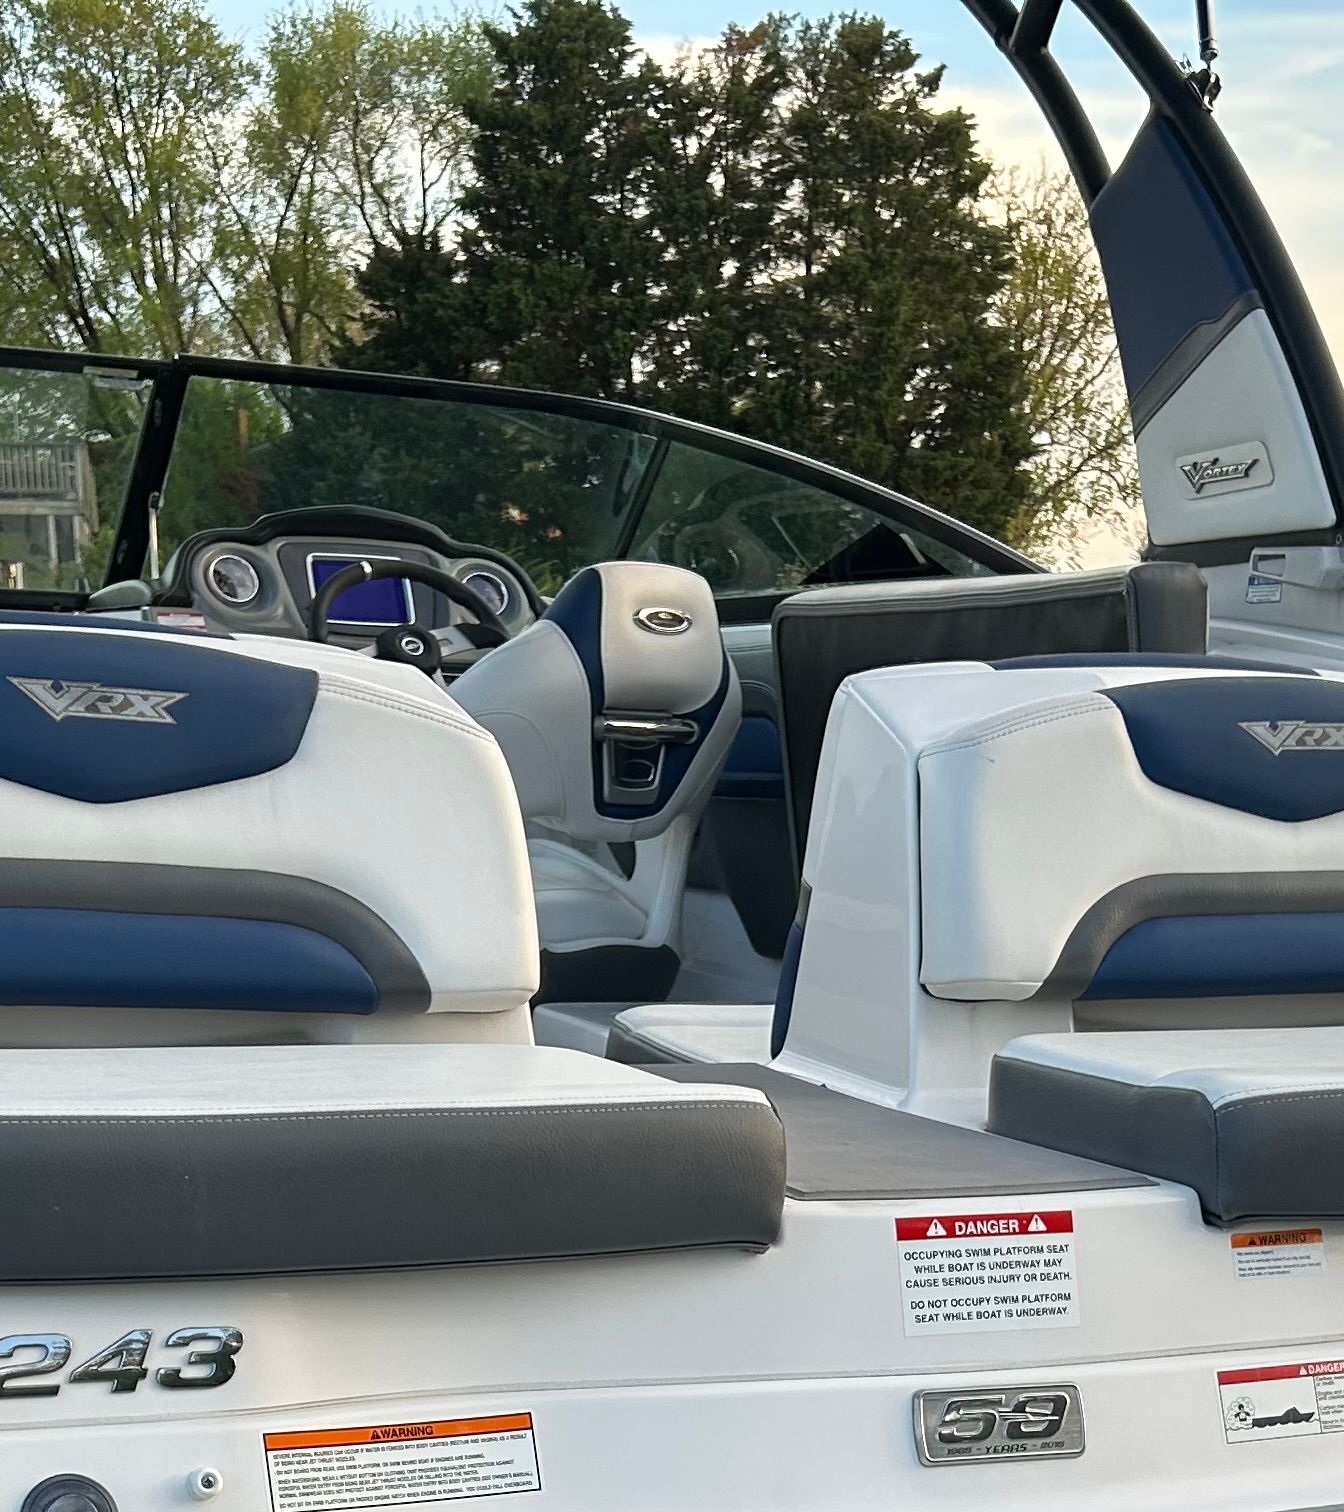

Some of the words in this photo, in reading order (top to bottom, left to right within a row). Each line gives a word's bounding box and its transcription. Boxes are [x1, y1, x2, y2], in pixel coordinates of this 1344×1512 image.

[6, 675, 190, 724] VRX
[955, 1219, 1020, 1236] DANGER
[1259, 1231, 1307, 1246] WARNING
[903, 1249, 963, 1261] OCCUPYING
[965, 1247, 991, 1258] SWIM
[993, 1245, 1044, 1257] PLATFORM
[1046, 1244, 1070, 1254] SEAT
[913, 1264, 945, 1274] WHILE
[947, 1262, 974, 1273] BOAT
[977, 1262, 986, 1271] IS
[988, 1259, 1042, 1270] UNDERWAY
[1043, 1258, 1063, 1268] MAY
[905, 1278, 940, 1289] CAUSE
[942, 1276, 985, 1287] SERIOUS
[987, 1274, 1022, 1285] INJURY
[1023, 1273, 1038, 1282] OR
[1039, 1271, 1073, 1282] DEATH.
[910, 1300, 925, 1310] DO
[927, 1299, 949, 1309] NOT
[950, 1297, 991, 1307] OCCUPY
[994, 1295, 1020, 1305] SWIM
[1021, 1292, 1072, 1304] PLATFORM
[914, 1313, 940, 1324] SEAT
[942, 1311, 974, 1322] WHILE
[976, 1309, 1003, 1320] BOAT
[1004, 1308, 1014, 1318] IS
[379, 1425, 434, 1440] WARNING
[984, 1444, 1028, 1455] YEARS
